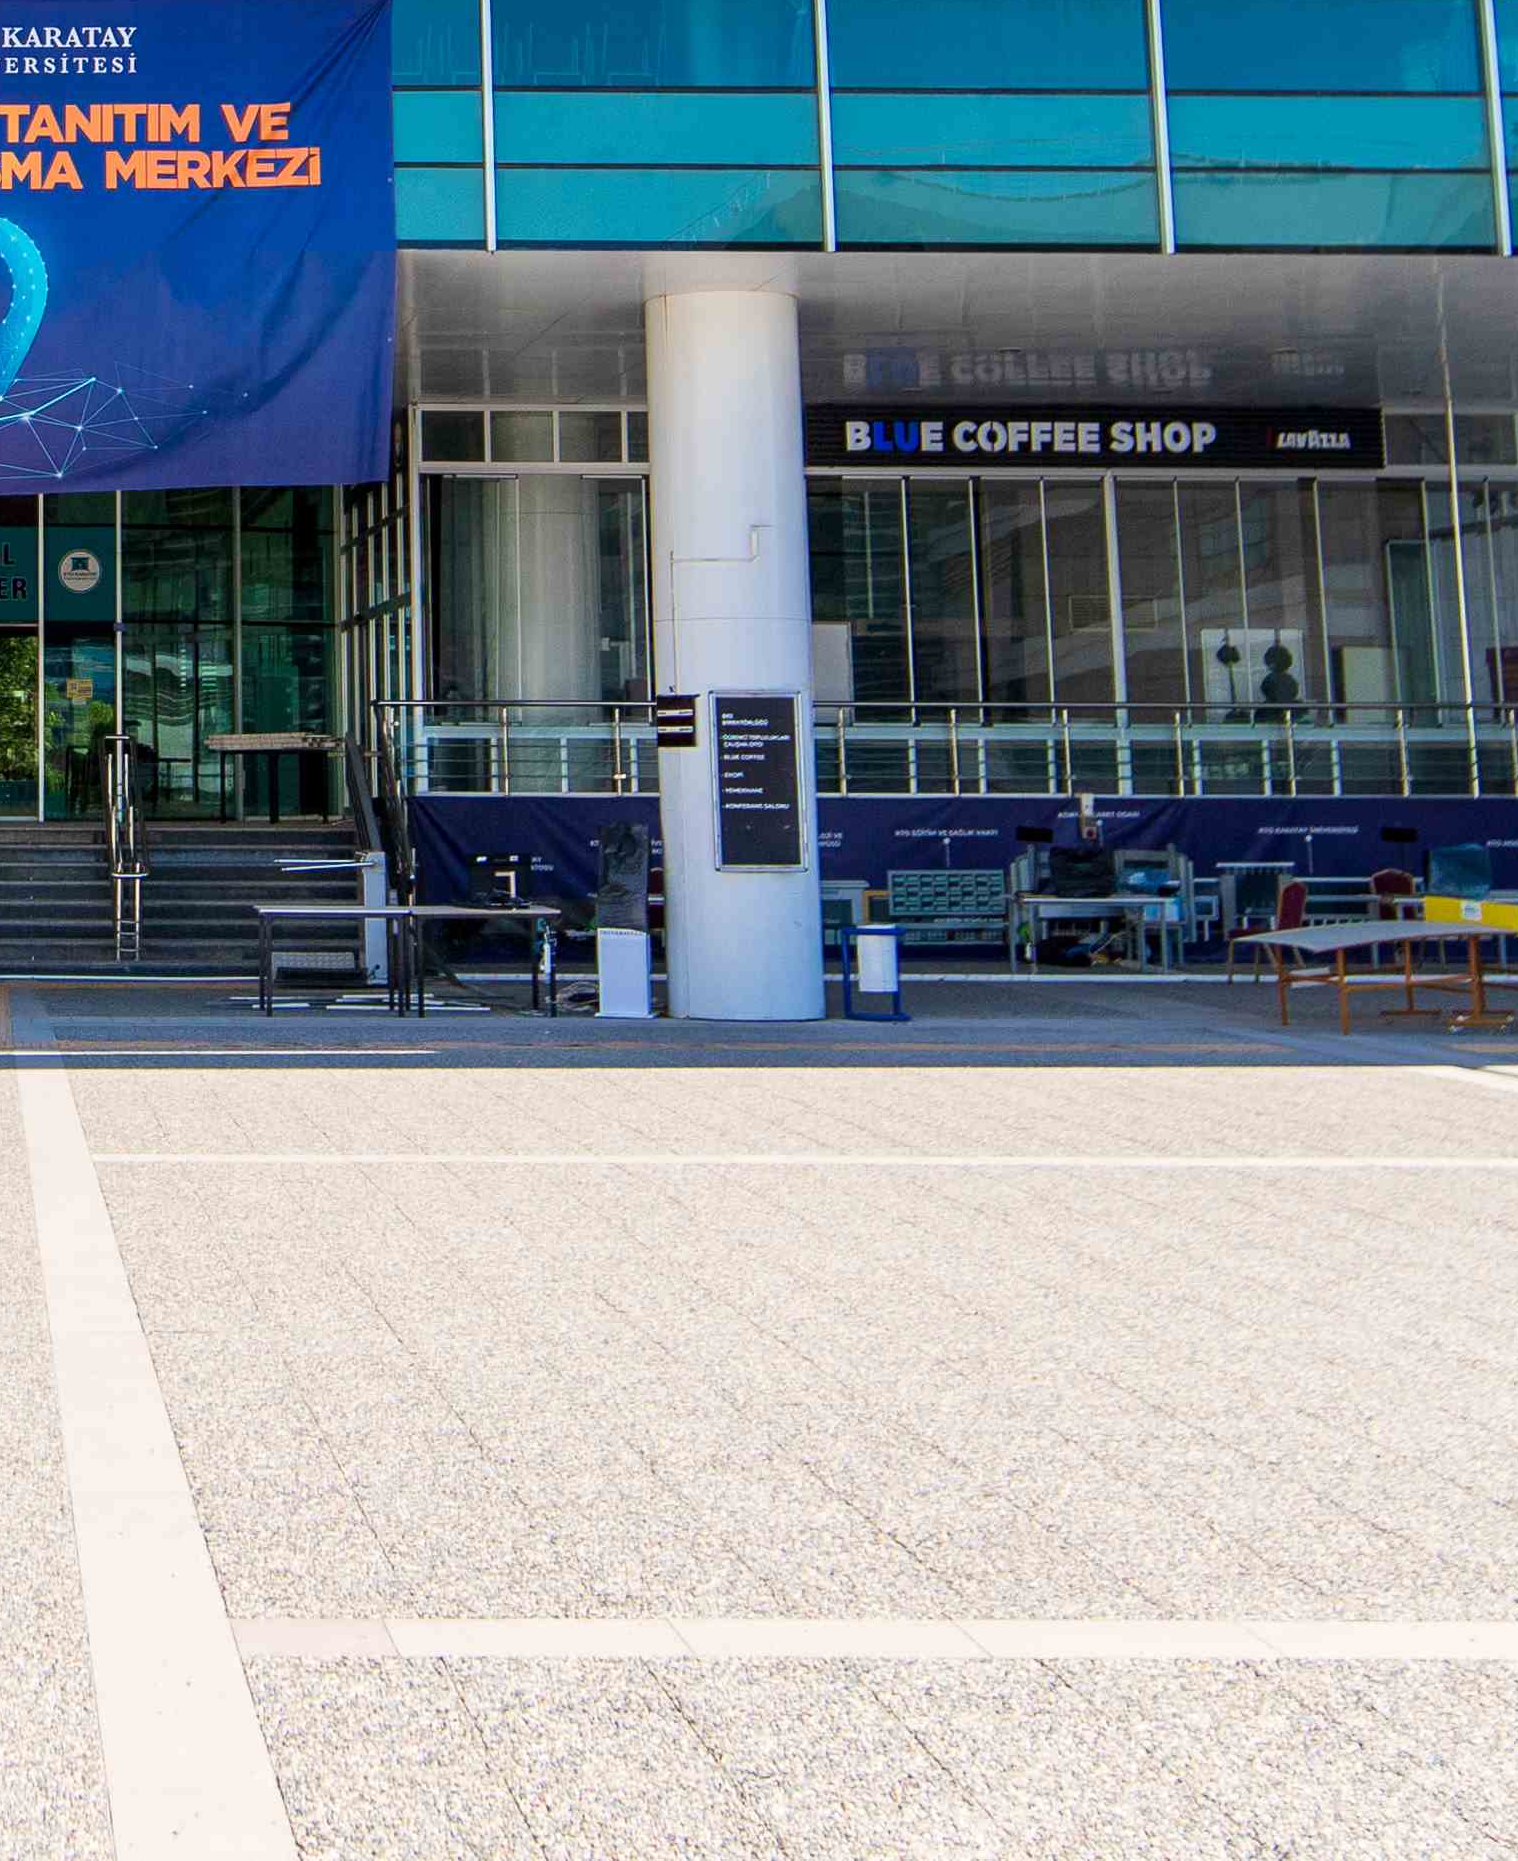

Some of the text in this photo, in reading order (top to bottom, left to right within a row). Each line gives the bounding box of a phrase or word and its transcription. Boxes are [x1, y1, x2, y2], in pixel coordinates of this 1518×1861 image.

[1, 26, 137, 48] KARATAY
[220, 101, 291, 142] VE
[105, 146, 321, 189] MERKEZİ
[845, 421, 1217, 453] BLUE COFFEE SHOP
[1276, 430, 1351, 449] LAVAZZA
